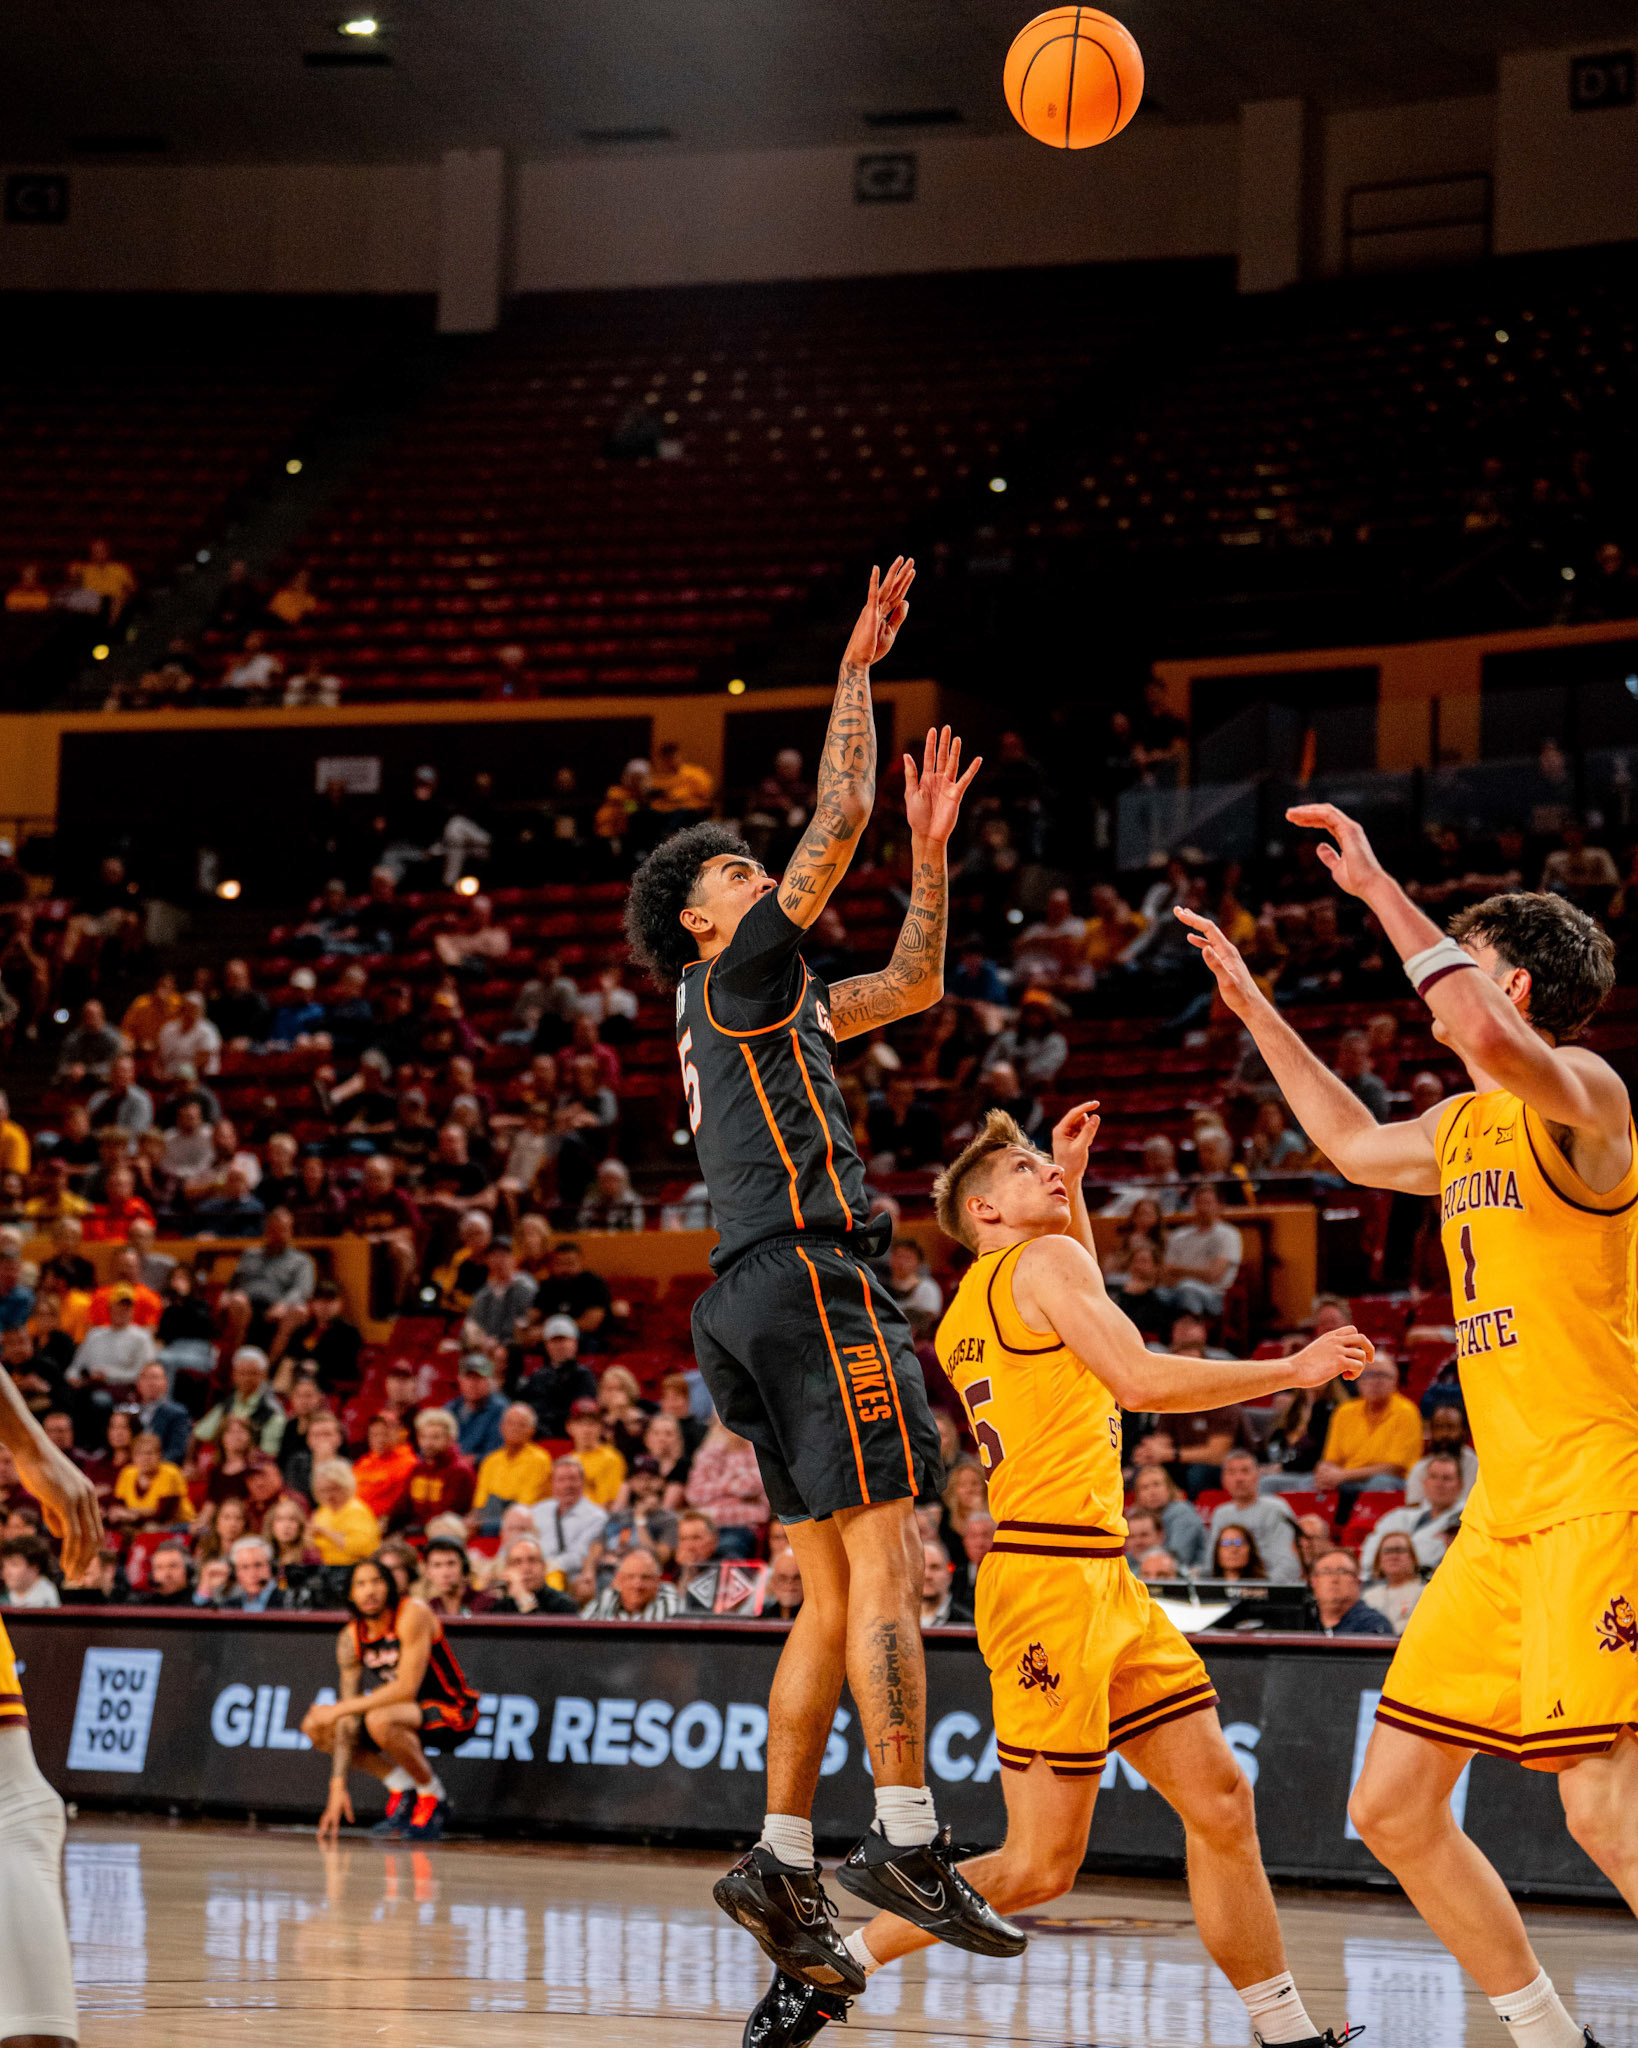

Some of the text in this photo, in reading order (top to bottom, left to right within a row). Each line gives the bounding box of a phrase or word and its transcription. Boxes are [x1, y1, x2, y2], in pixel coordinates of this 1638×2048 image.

[1578, 64, 1628, 99] D1
[16, 184, 60, 215] C1
[678, 1026, 702, 1136] 5
[1460, 1224, 1477, 1302] 1
[842, 1343, 892, 1423] POKES
[962, 1376, 1008, 1484] 5
[97, 1668, 148, 1692] YOU
[99, 1699, 131, 1722] DO
[884, 1633, 905, 1728] JESUS
[87, 1727, 136, 1752] YOU
[547, 1696, 852, 1776] RESORS
